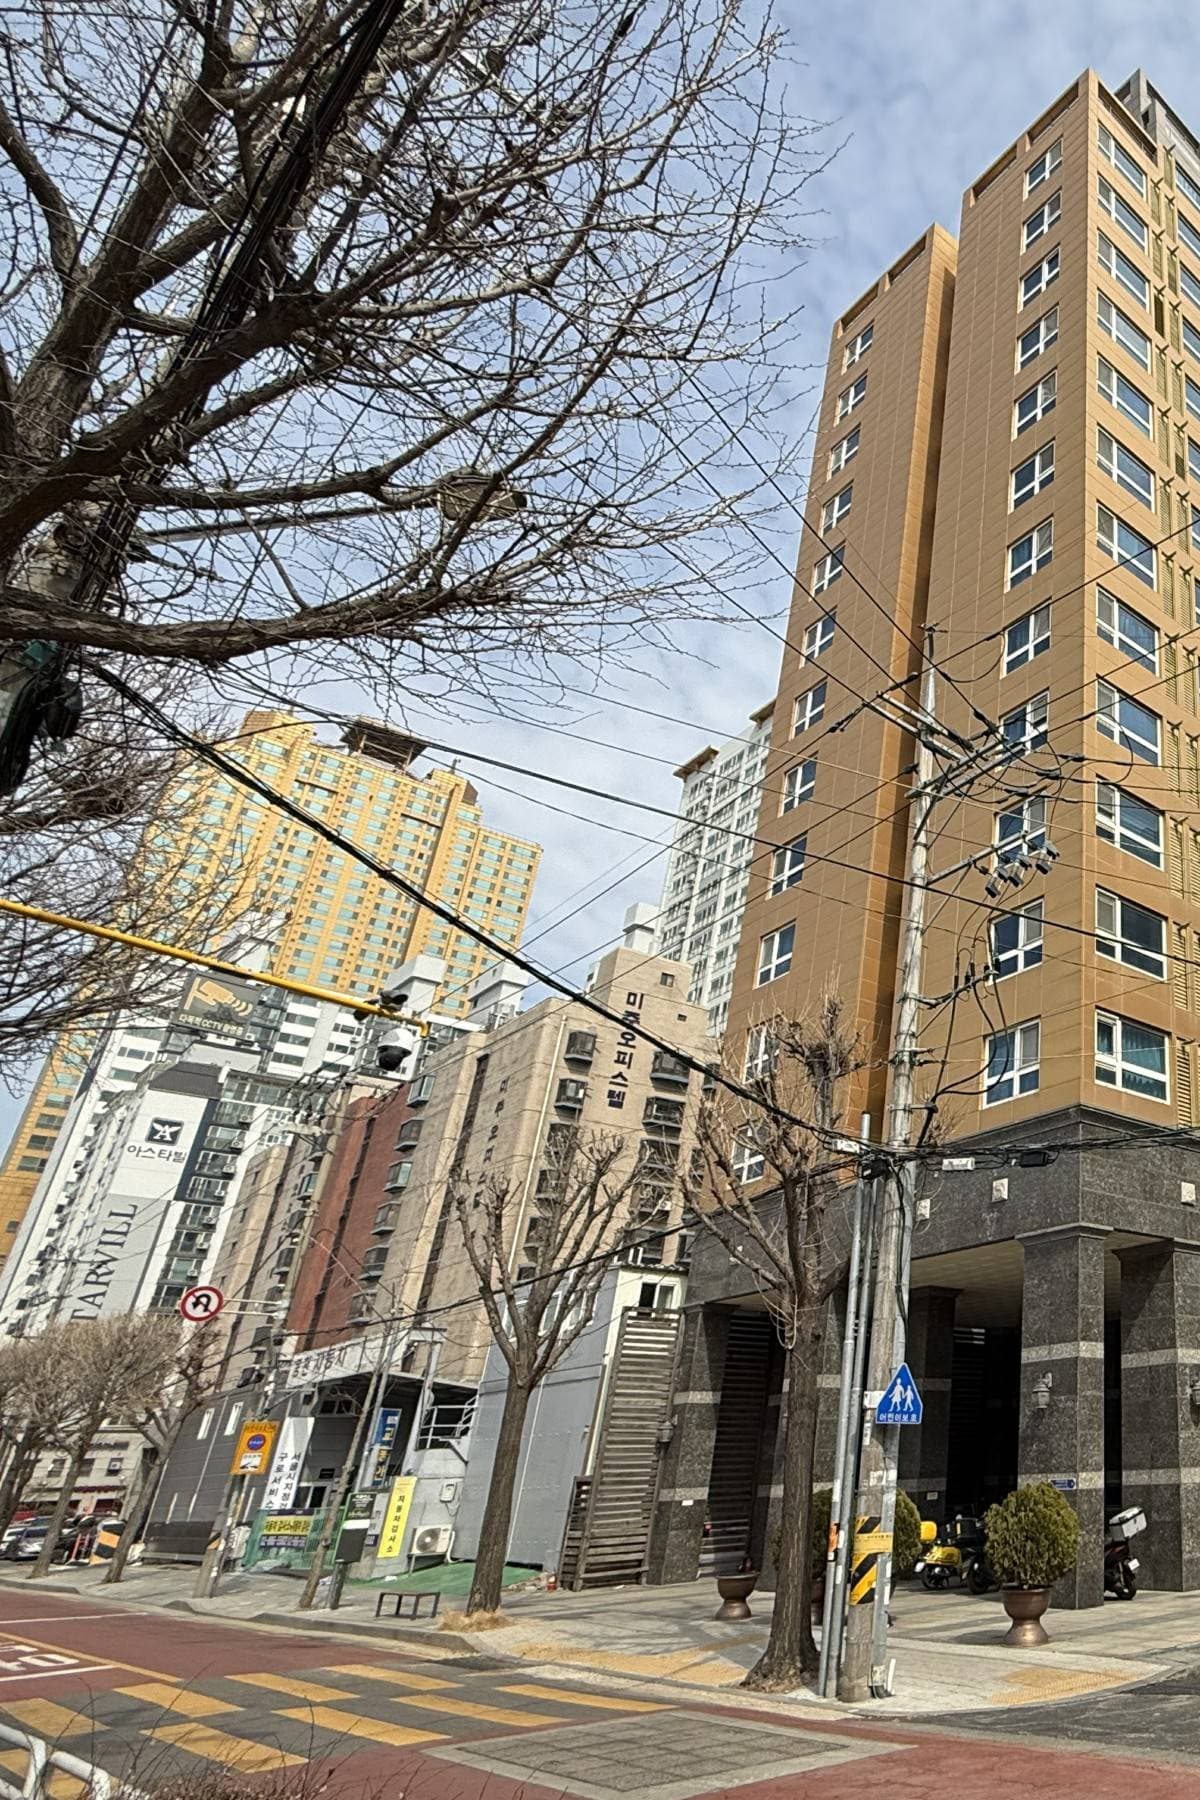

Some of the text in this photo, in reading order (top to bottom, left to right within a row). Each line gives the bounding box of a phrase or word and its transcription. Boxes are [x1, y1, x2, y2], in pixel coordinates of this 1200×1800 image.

[201, 1018, 223, 1030] CCTV
[607, 991, 644, 1109] 미주오피스텔
[127, 1145, 187, 1163] 아스타빌
[880, 1412, 917, 1422] 어린이보호
[265, 1452, 288, 1508] 구로서비스
[386, 1494, 405, 1552] 자동차검사소
